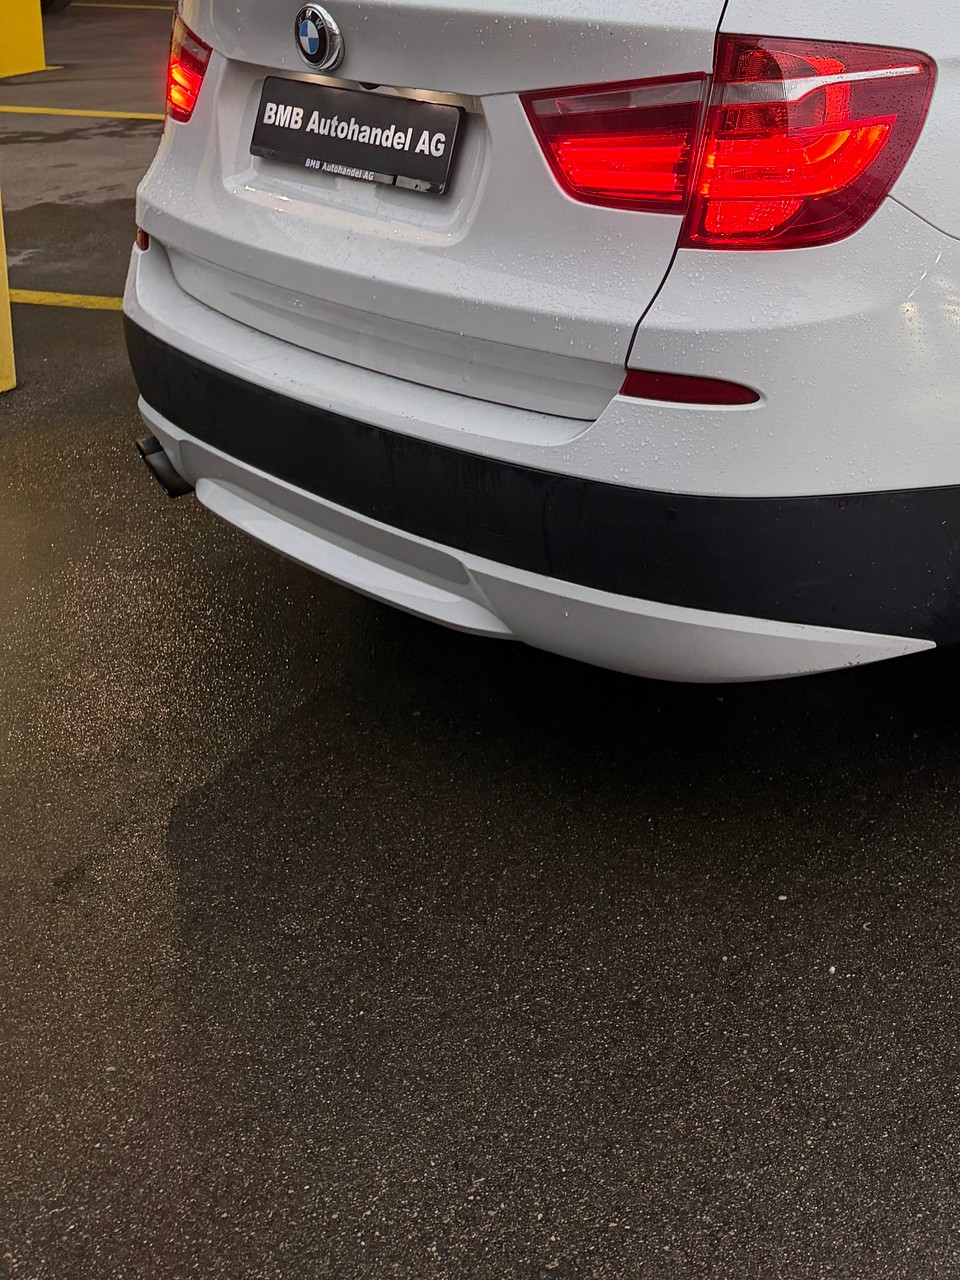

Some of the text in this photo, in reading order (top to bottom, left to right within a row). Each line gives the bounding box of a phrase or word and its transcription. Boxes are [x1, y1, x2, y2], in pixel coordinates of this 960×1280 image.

[263, 102, 446, 158] BMB Autohandel AG
[305, 158, 375, 181] BMB Autohandel AG
